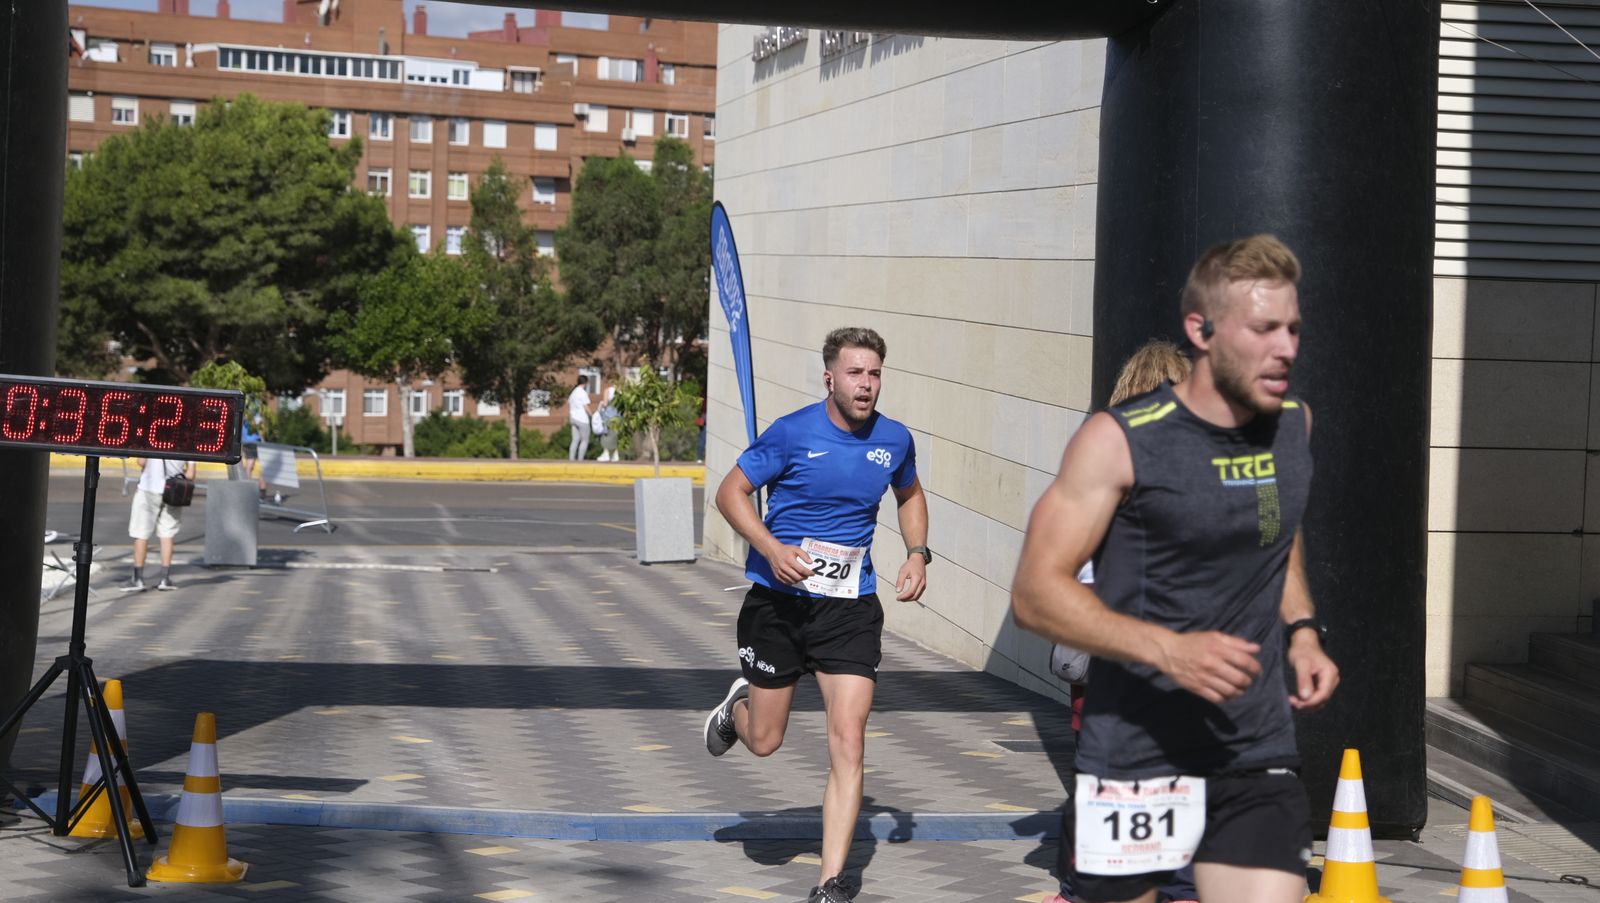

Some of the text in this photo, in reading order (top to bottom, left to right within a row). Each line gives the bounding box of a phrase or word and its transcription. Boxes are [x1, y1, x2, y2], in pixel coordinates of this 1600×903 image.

[2, 384, 228, 452] 0:36:23
[866, 448, 892, 465] ego
[1211, 453, 1276, 480] TRG
[812, 558, 851, 580] 220
[756, 660, 776, 674] NEXA
[1103, 808, 1175, 842] 181
